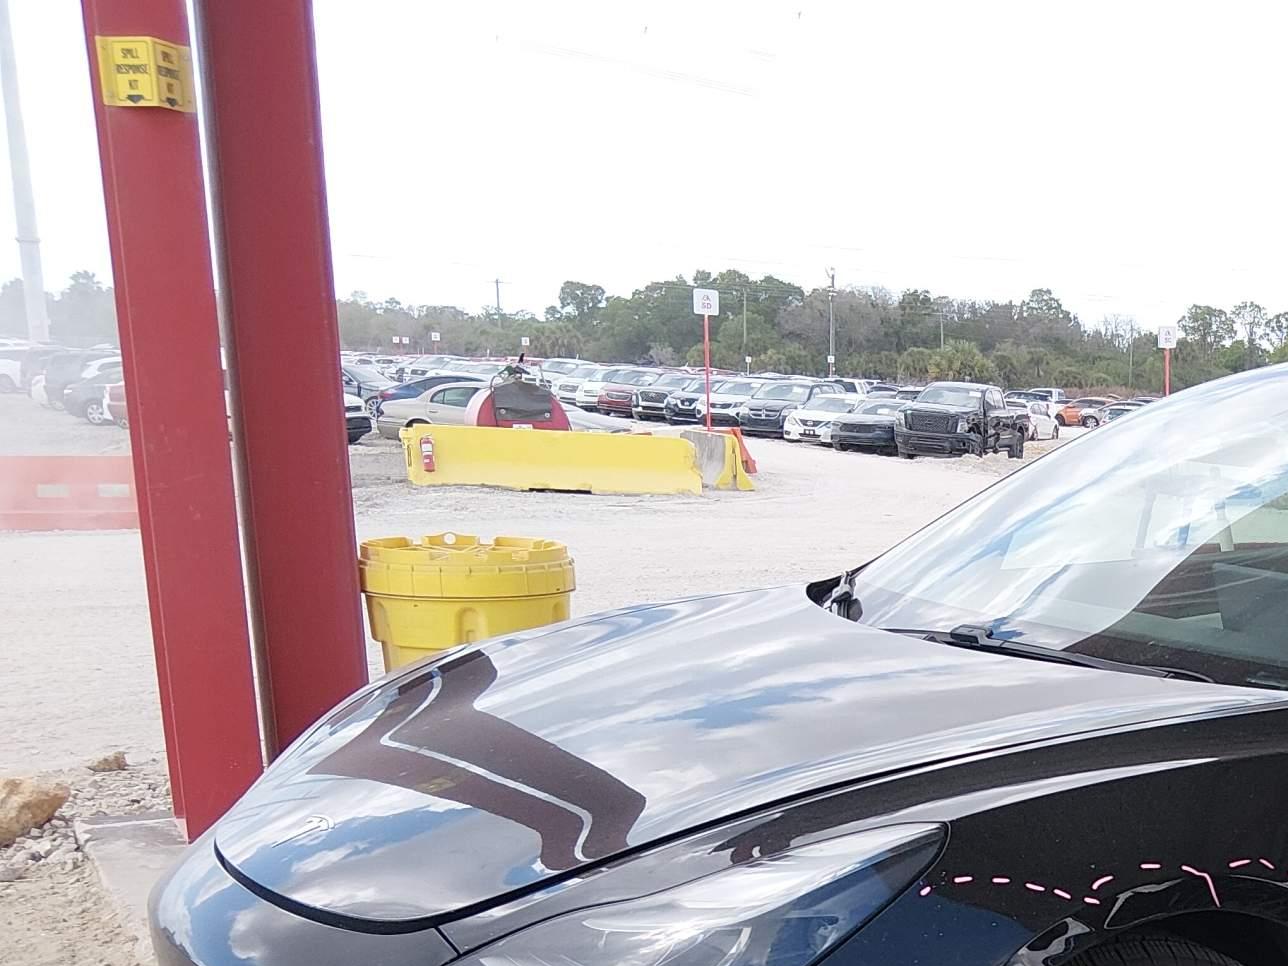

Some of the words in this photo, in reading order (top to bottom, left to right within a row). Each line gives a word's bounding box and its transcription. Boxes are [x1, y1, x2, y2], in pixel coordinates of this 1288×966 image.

[121, 48, 140, 59] SPILL
[115, 63, 149, 75] RESPONSE
[128, 79, 139, 90] KIT
